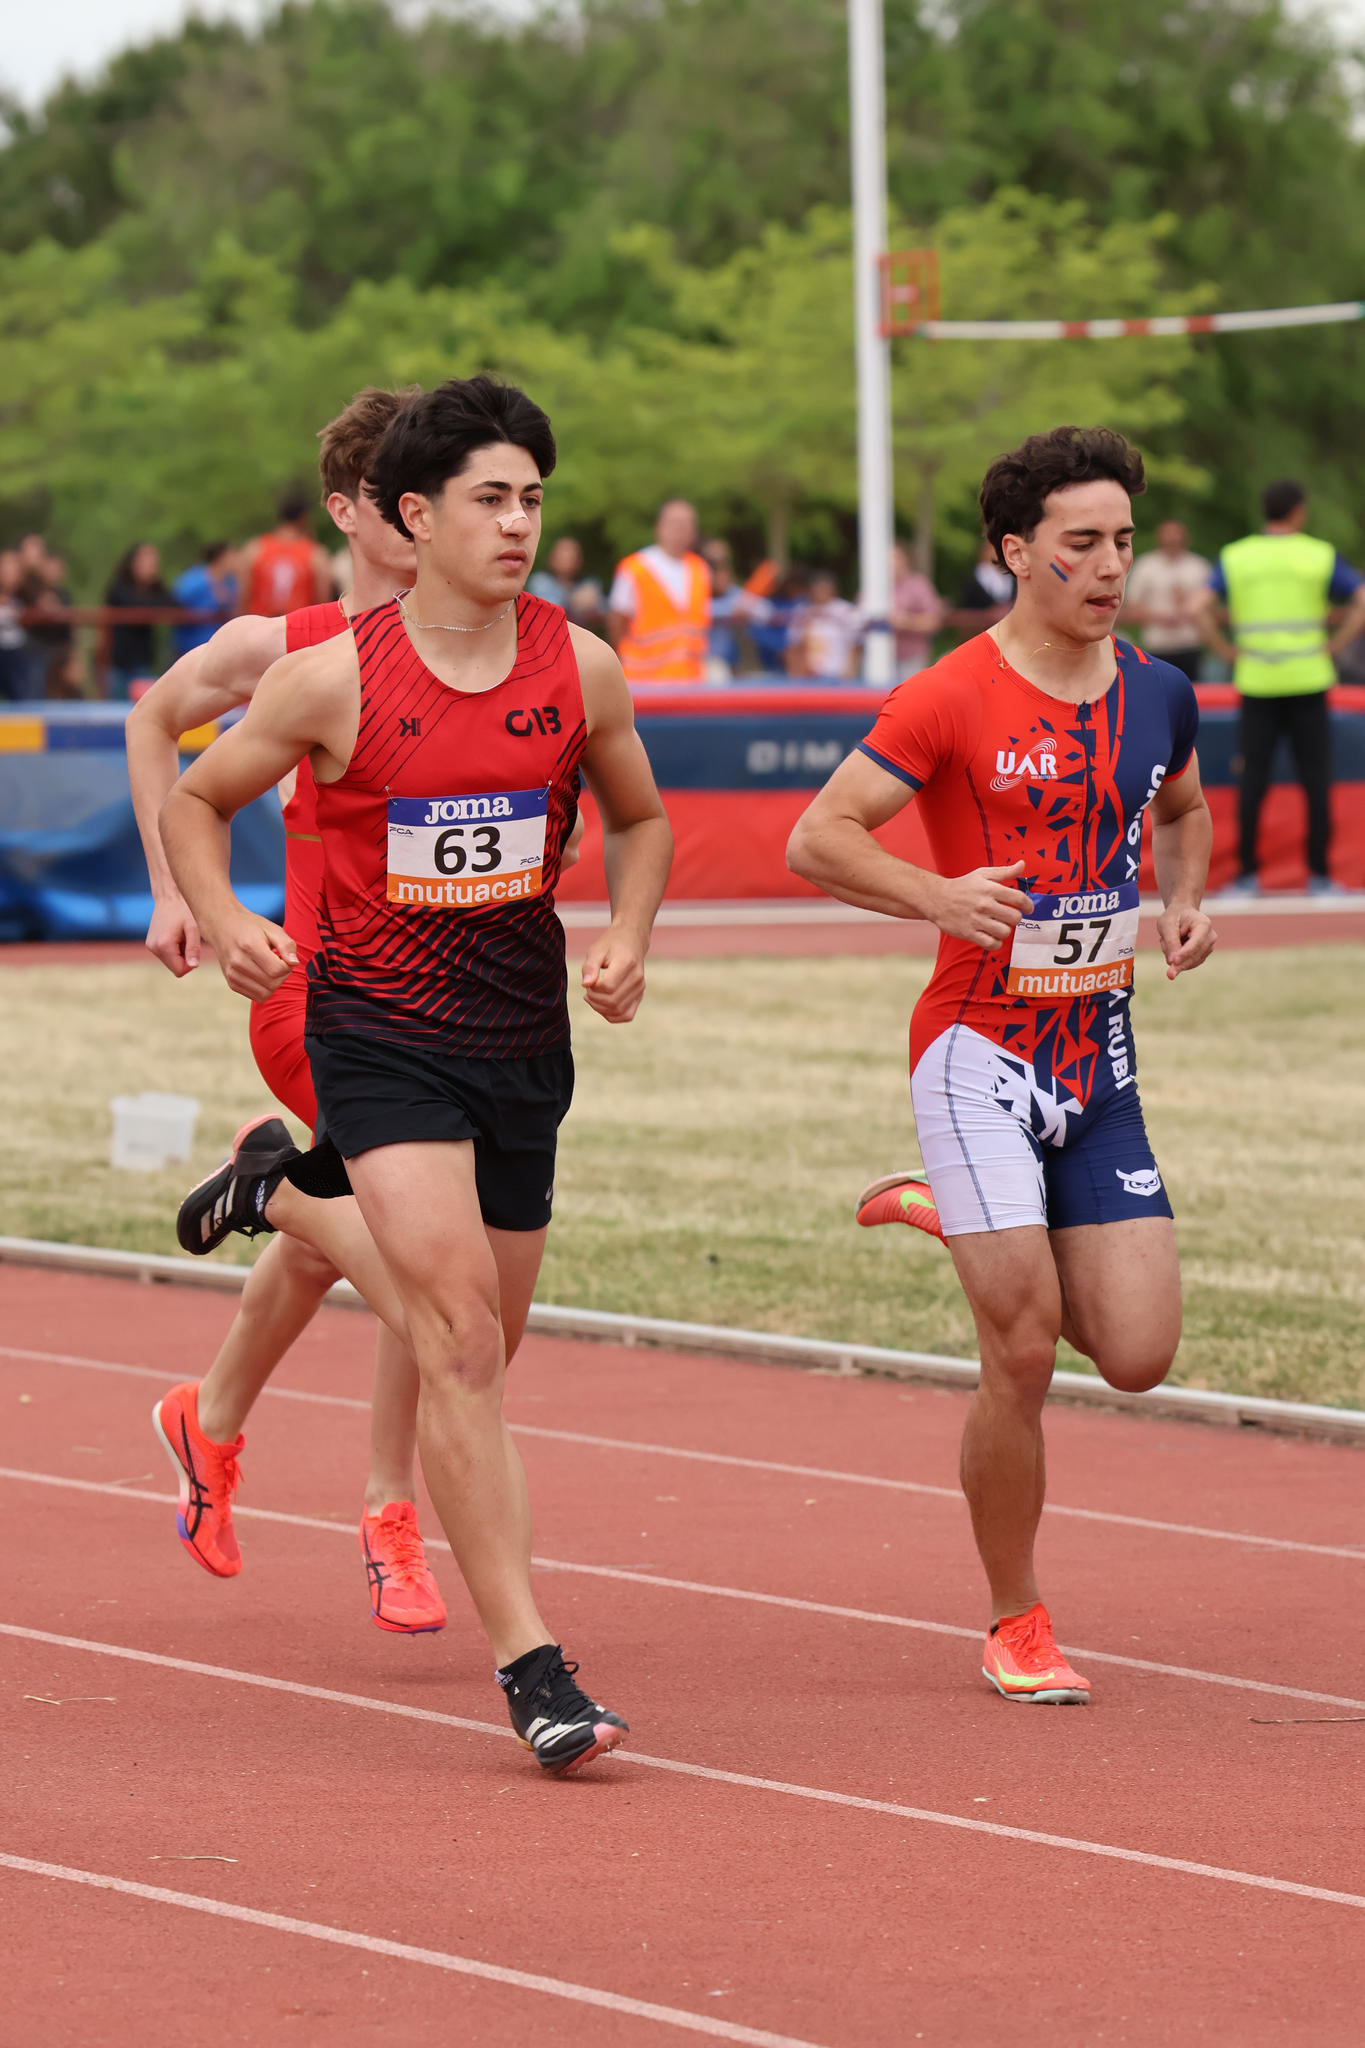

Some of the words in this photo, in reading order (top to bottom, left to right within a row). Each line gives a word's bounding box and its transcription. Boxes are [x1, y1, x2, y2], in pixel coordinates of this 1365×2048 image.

[996, 750, 1058, 775] UAR
[434, 826, 502, 875] 63
[398, 872, 532, 904] mutuacat
[1053, 918, 1112, 965] 57
[1018, 963, 1127, 994] mutuacat
